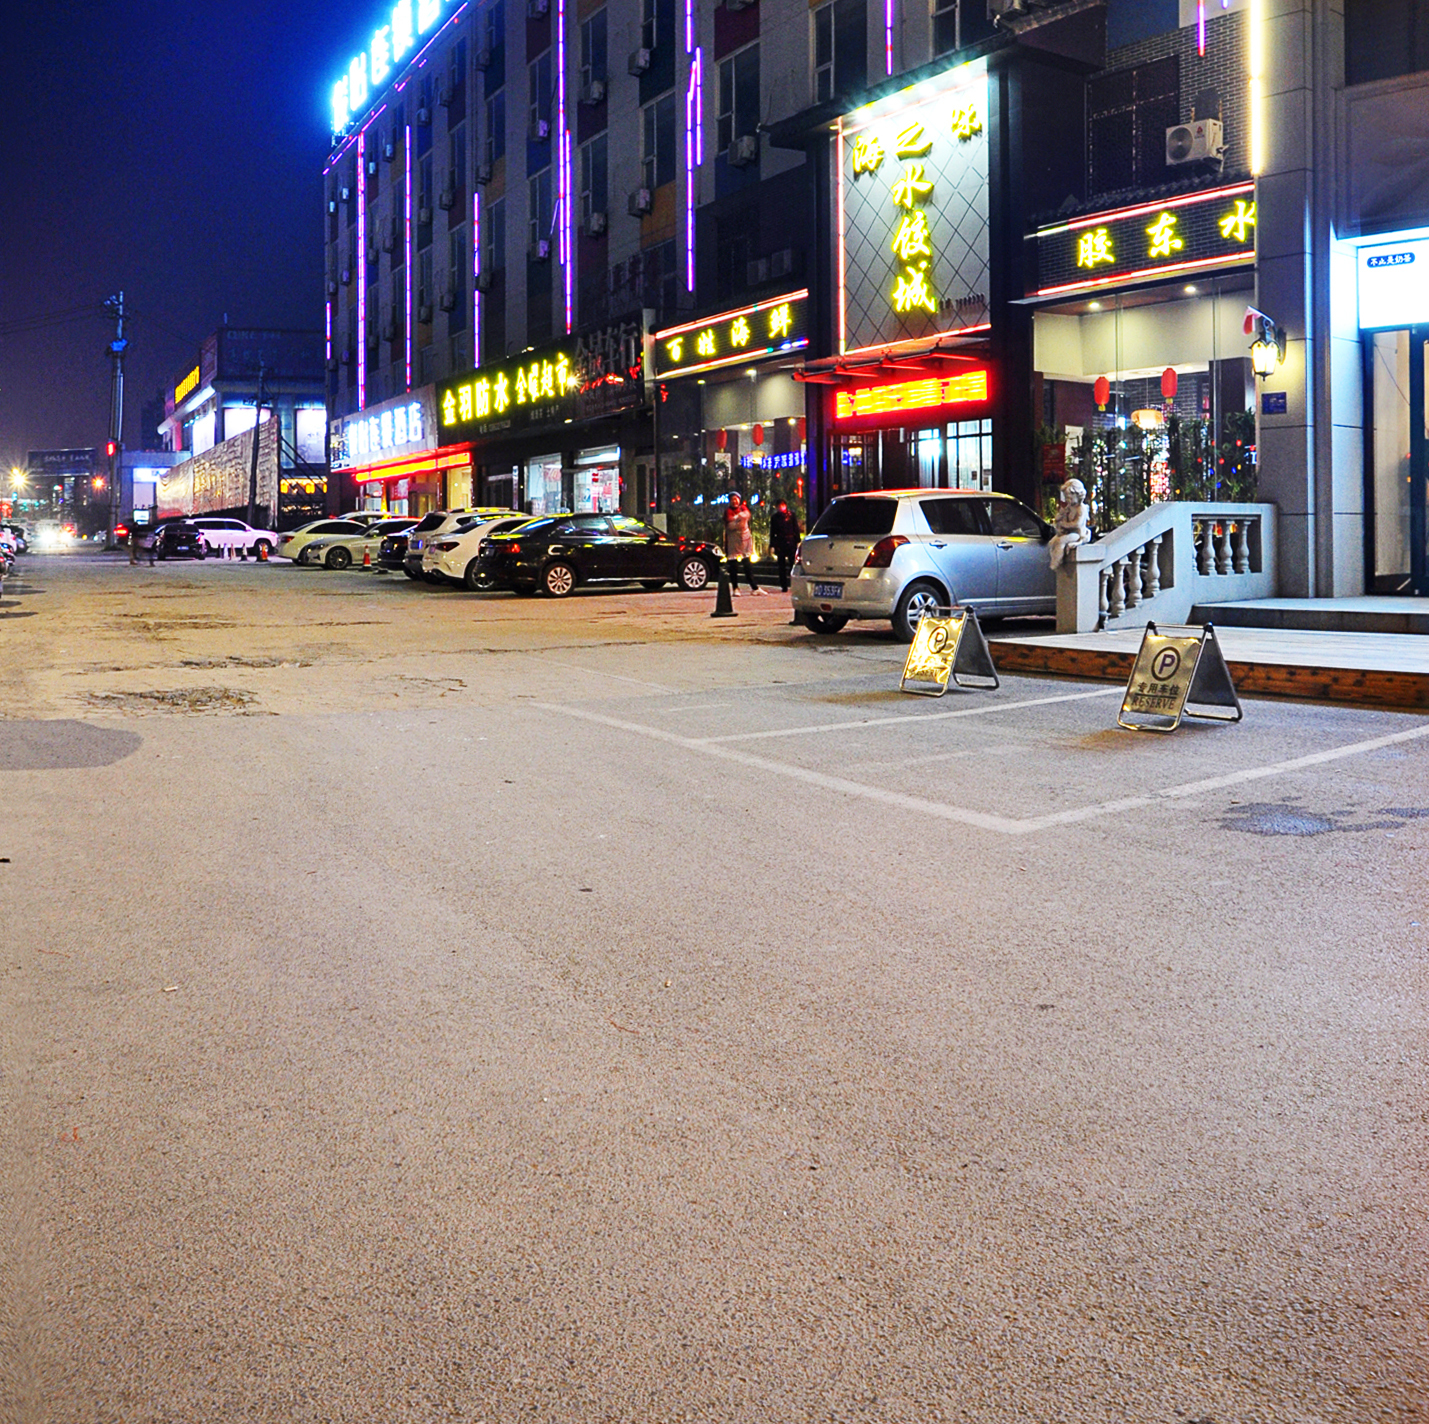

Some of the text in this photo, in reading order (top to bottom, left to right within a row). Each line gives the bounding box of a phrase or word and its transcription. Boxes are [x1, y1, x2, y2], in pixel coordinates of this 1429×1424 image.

[891, 163, 938, 314] 水饺城
[1136, 682, 1180, 697] 专用车位
[1131, 694, 1176, 710] RESERVE
